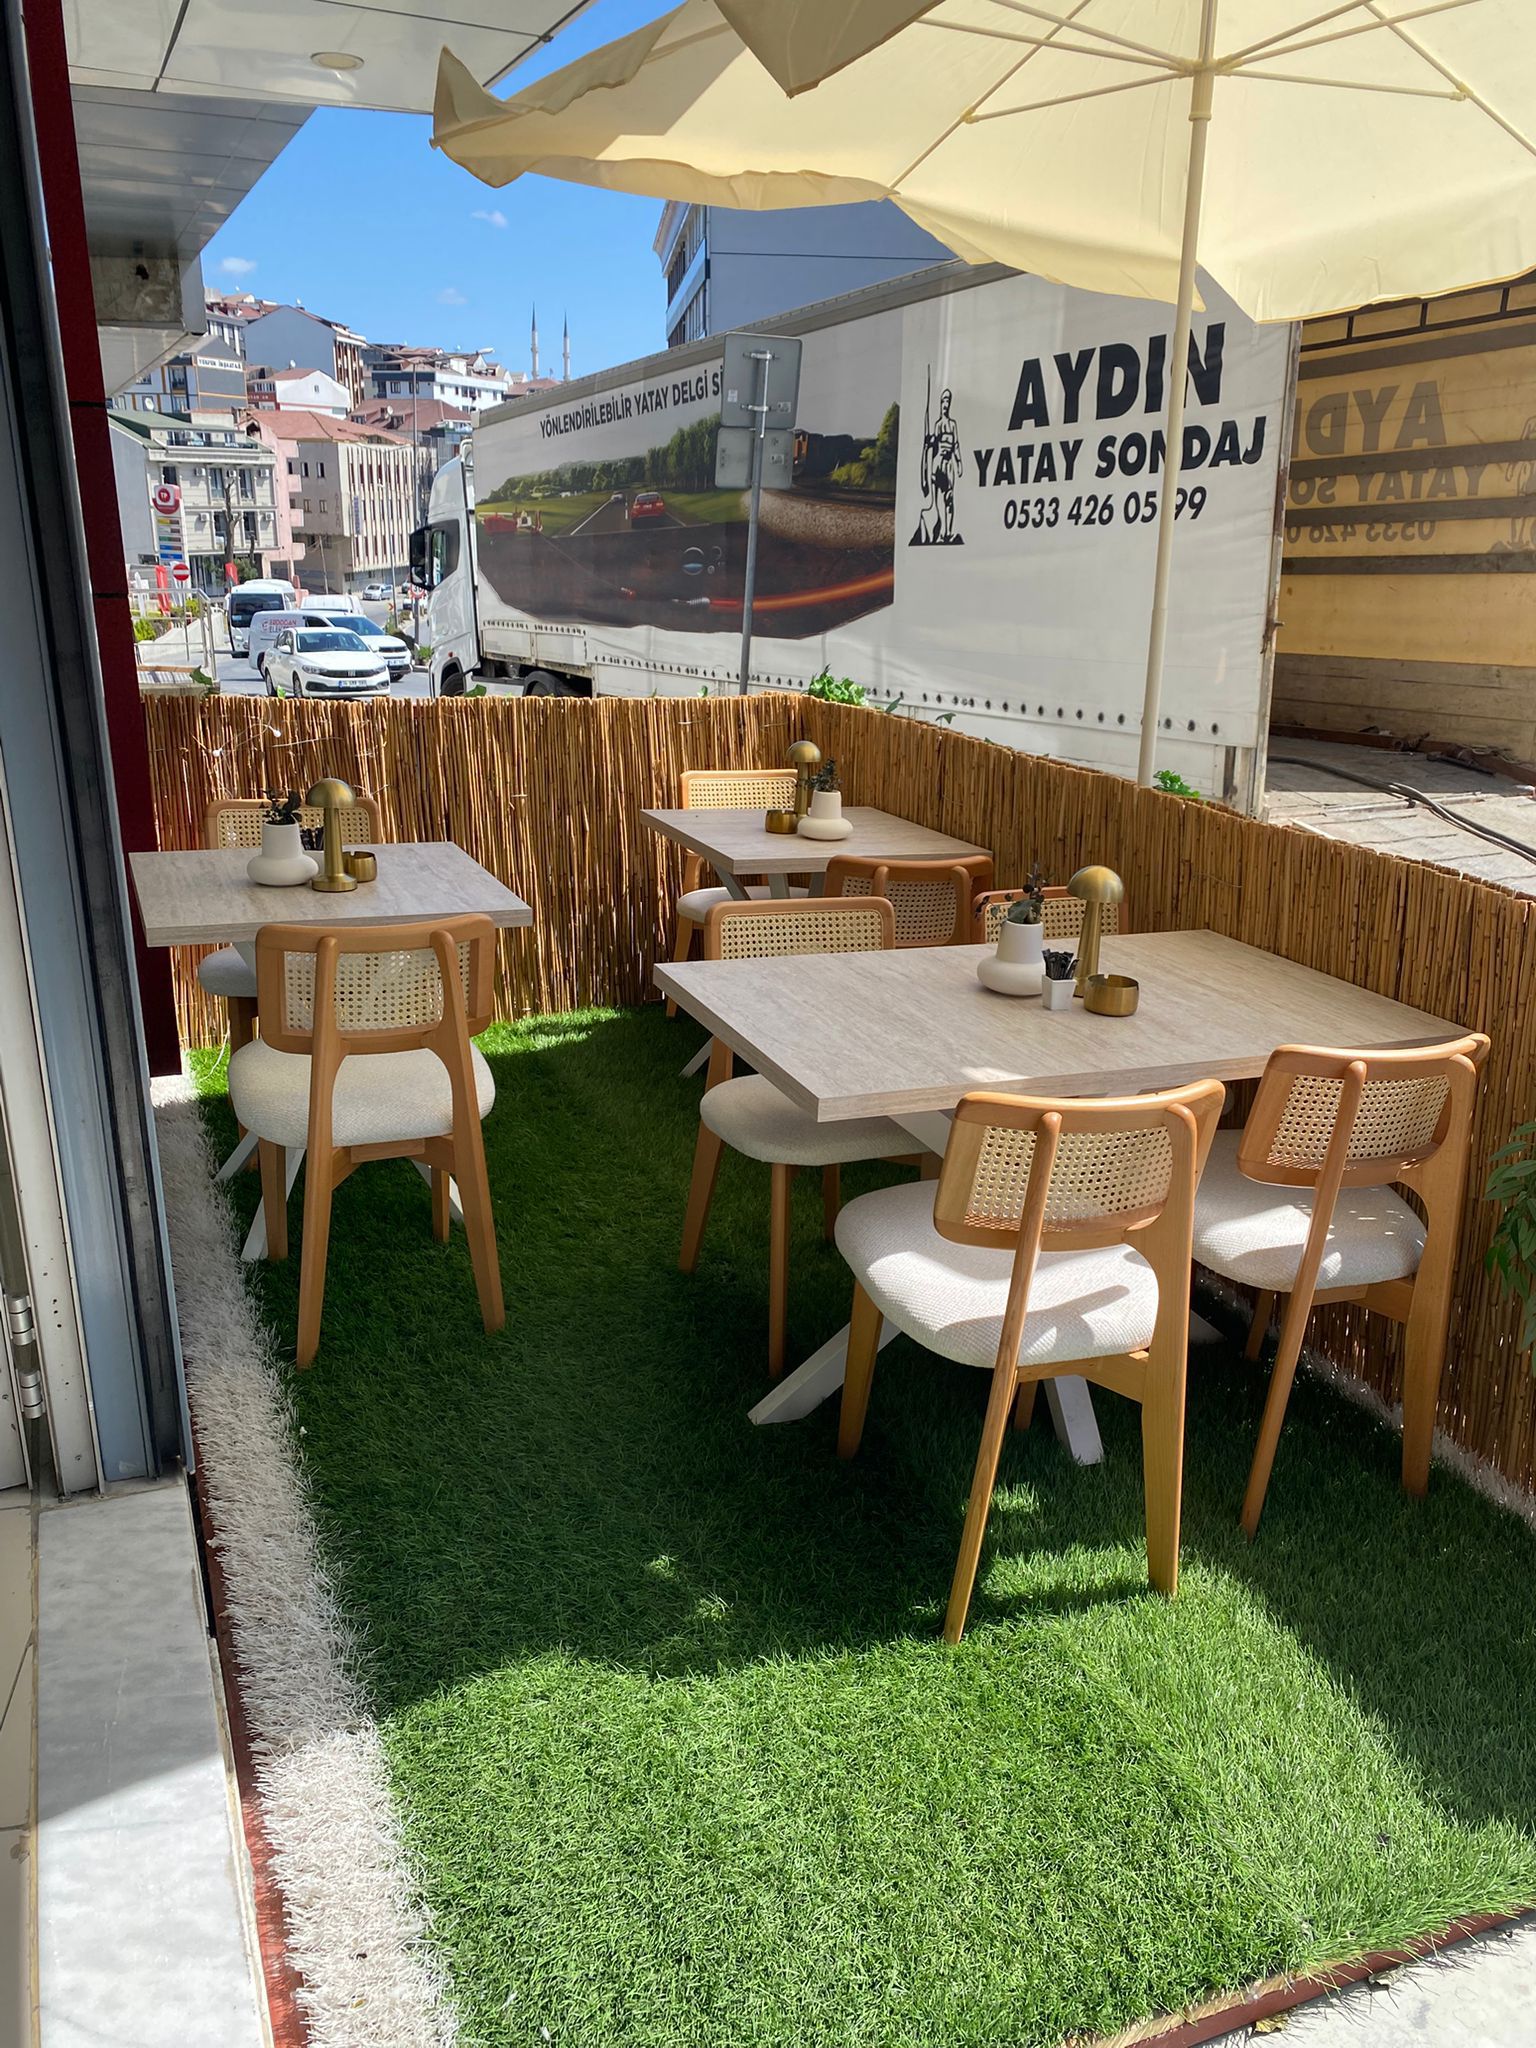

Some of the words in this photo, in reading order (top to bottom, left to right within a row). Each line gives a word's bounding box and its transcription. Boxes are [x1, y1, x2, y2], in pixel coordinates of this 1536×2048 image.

[540, 393, 632, 439] YÖNLENDİRİLEBİLİR
[634, 386, 669, 416] YATAY
[672, 369, 708, 406] DELGİ
[1007, 322, 1226, 431] AYDIN
[973, 439, 1083, 488] YATAY
[1095, 416, 1266, 479] SONDAJ
[1004, 497, 1059, 529] 0533
[1067, 494, 1113, 526] 426
[1123, 489, 1157, 524] 05
